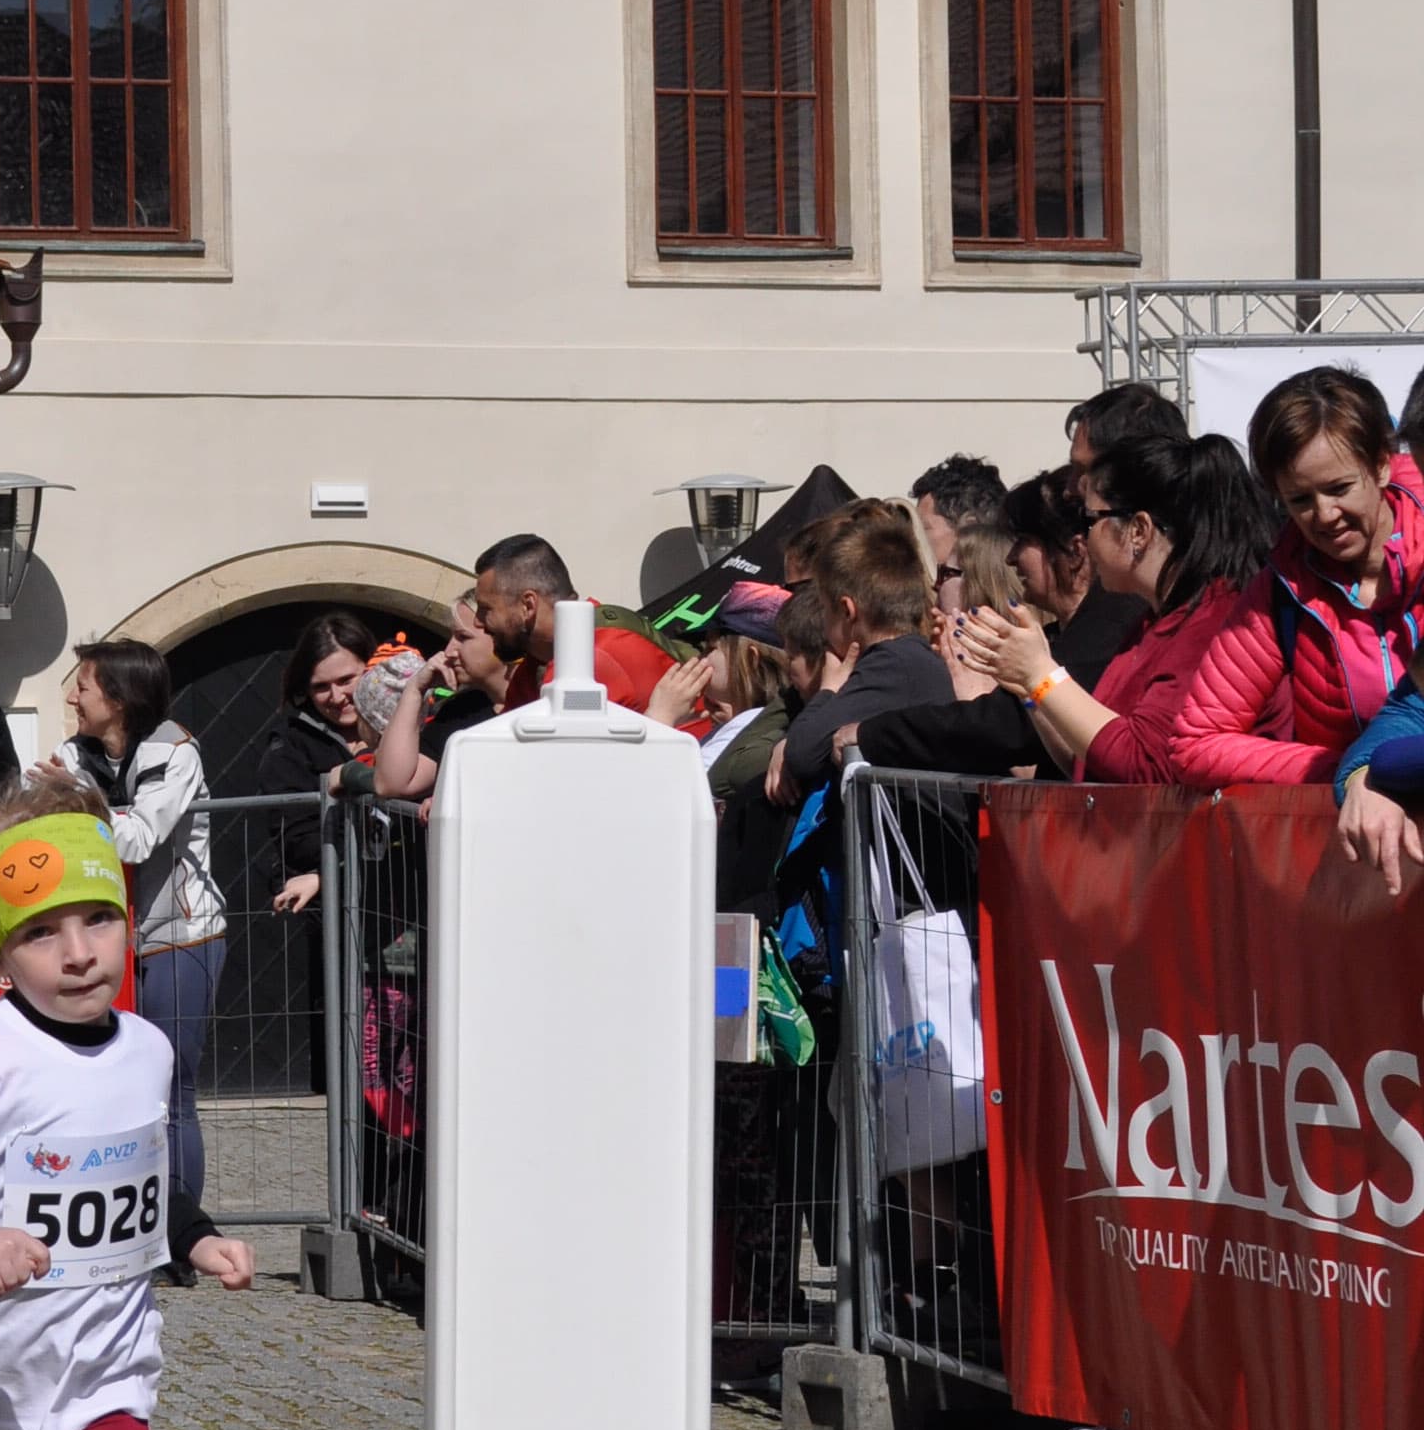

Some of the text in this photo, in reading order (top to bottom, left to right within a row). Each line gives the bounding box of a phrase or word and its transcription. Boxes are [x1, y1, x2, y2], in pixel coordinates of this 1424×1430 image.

[103, 1141, 138, 1161] PVZP
[26, 1175, 160, 1249] 5028
[1119, 1226, 1209, 1273] QUALITY
[1308, 1258, 1392, 1308] SPRING
